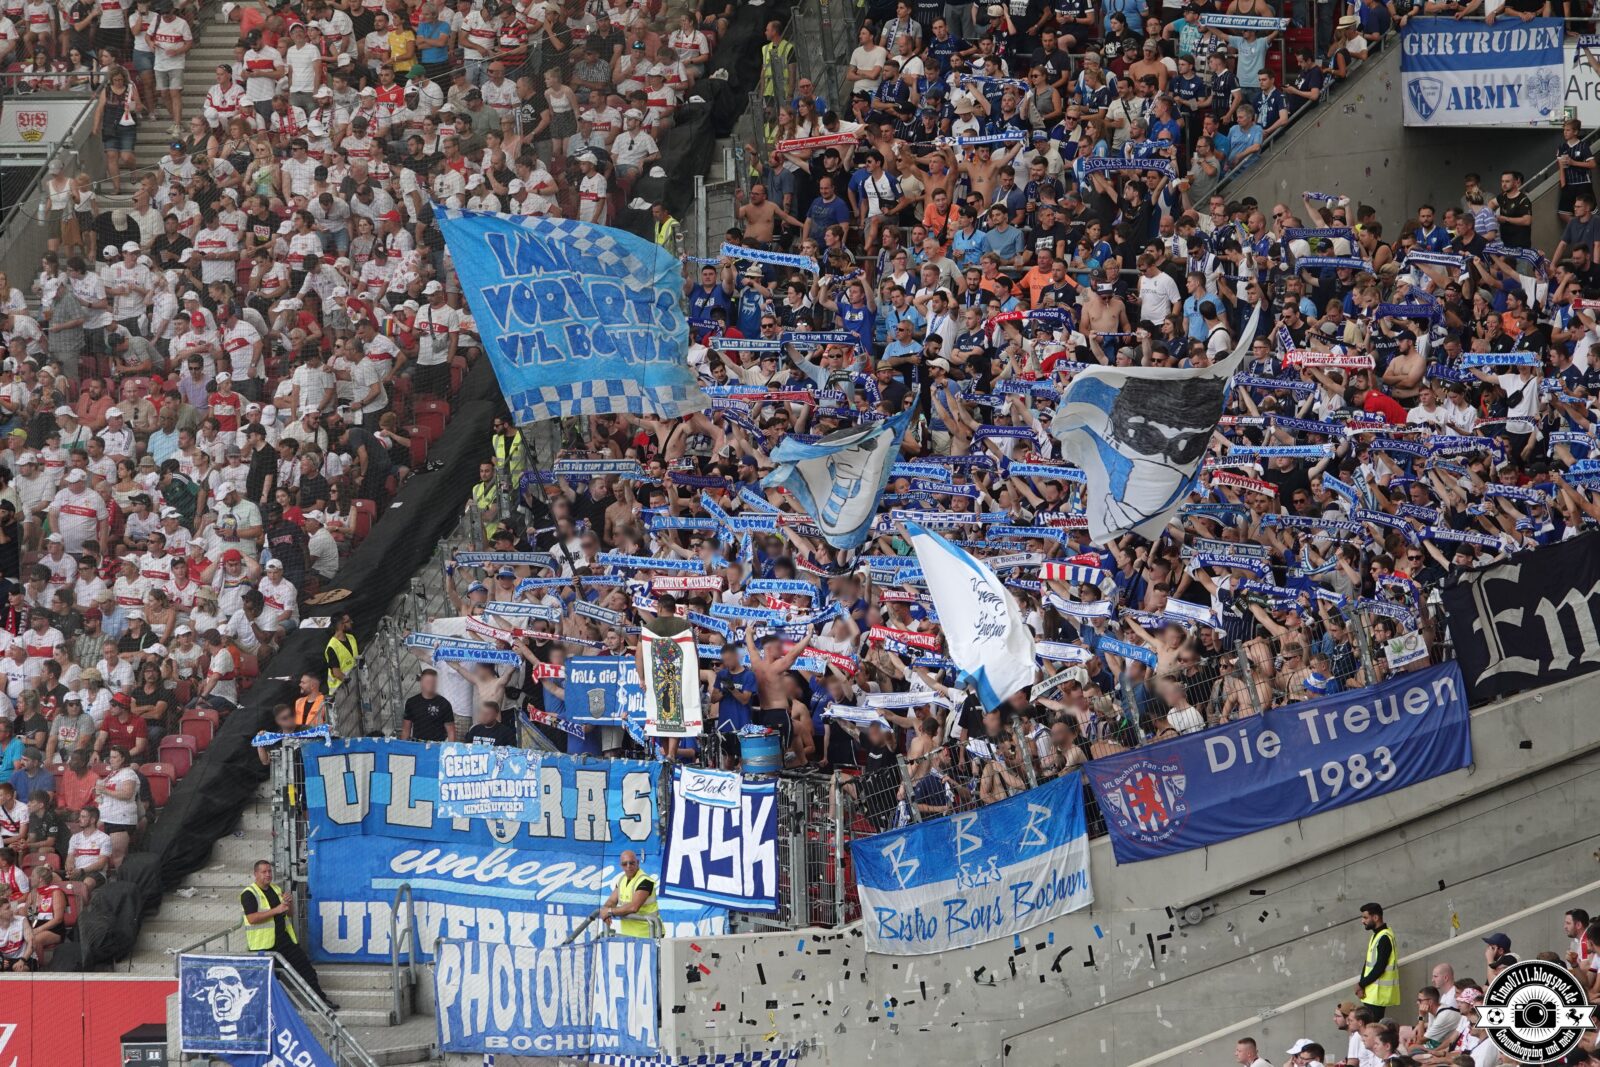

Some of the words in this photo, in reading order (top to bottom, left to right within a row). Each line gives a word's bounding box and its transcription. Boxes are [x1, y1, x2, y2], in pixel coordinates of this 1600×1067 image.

[1403, 26, 1562, 56] GERTRUDEN
[1446, 84, 1522, 110] ARMY
[1084, 159, 1122, 171] STOLZES
[1125, 159, 1166, 169] MITGLIED
[1032, 311, 1059, 319] BOCHUM
[791, 332, 806, 340] ECHO
[822, 333, 832, 341] THE
[1481, 355, 1526, 364] BOCHUM
[1293, 381, 1314, 389] 1848
[1221, 453, 1255, 465] BOCHUM
[931, 483, 953, 491] Bochum
[733, 519, 775, 528] BOCHUM
[1312, 518, 1362, 533] BOCHUM
[1366, 512, 1391, 523] Bochum
[1392, 518, 1407, 529] 1848
[456, 553, 506, 562] OSTKURVE
[512, 553, 551, 564] BOCHUM
[870, 557, 914, 567] BOCHUM
[1000, 555, 1025, 564] Bochum
[1213, 555, 1250, 565] BOCHUM
[654, 577, 684, 588] DKURVE
[599, 668, 617, 684] die
[1204, 728, 1281, 773] Die
[1298, 674, 1459, 745] Treuen
[445, 753, 490, 778] GEGEN
[1114, 762, 1141, 786] Bochum
[1299, 745, 1397, 803] 1983
[686, 774, 727, 797] Block
[318, 752, 652, 843] ULRAS
[1175, 804, 1186, 812] 83
[882, 838, 920, 890] B
[952, 812, 982, 865] B
[1019, 803, 1051, 852] B
[390, 847, 661, 901] unbequ
[956, 856, 1003, 890] 1848
[874, 907, 937, 942] Bistro
[944, 897, 1004, 935] Boys
[1010, 869, 1088, 919] Bochum
[438, 941, 657, 1048] PHOTOMAFIA
[484, 1034, 620, 1049] BOCHUM
